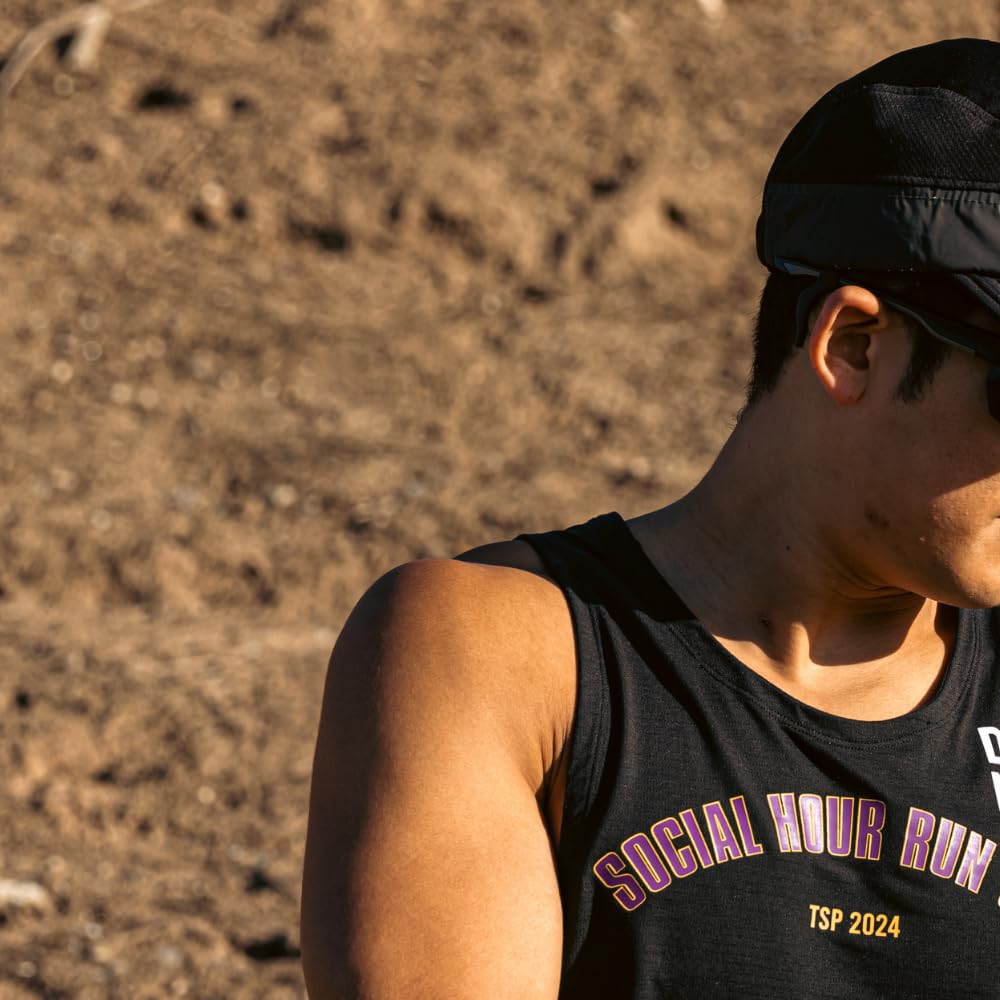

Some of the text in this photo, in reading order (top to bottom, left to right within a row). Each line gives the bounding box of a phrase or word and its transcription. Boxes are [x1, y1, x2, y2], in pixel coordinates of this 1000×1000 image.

[593, 795, 763, 912] SOCIAL
[766, 792, 887, 860] HOUR
[900, 806, 998, 894] RUN
[809, 904, 901, 938] TSP 2024
